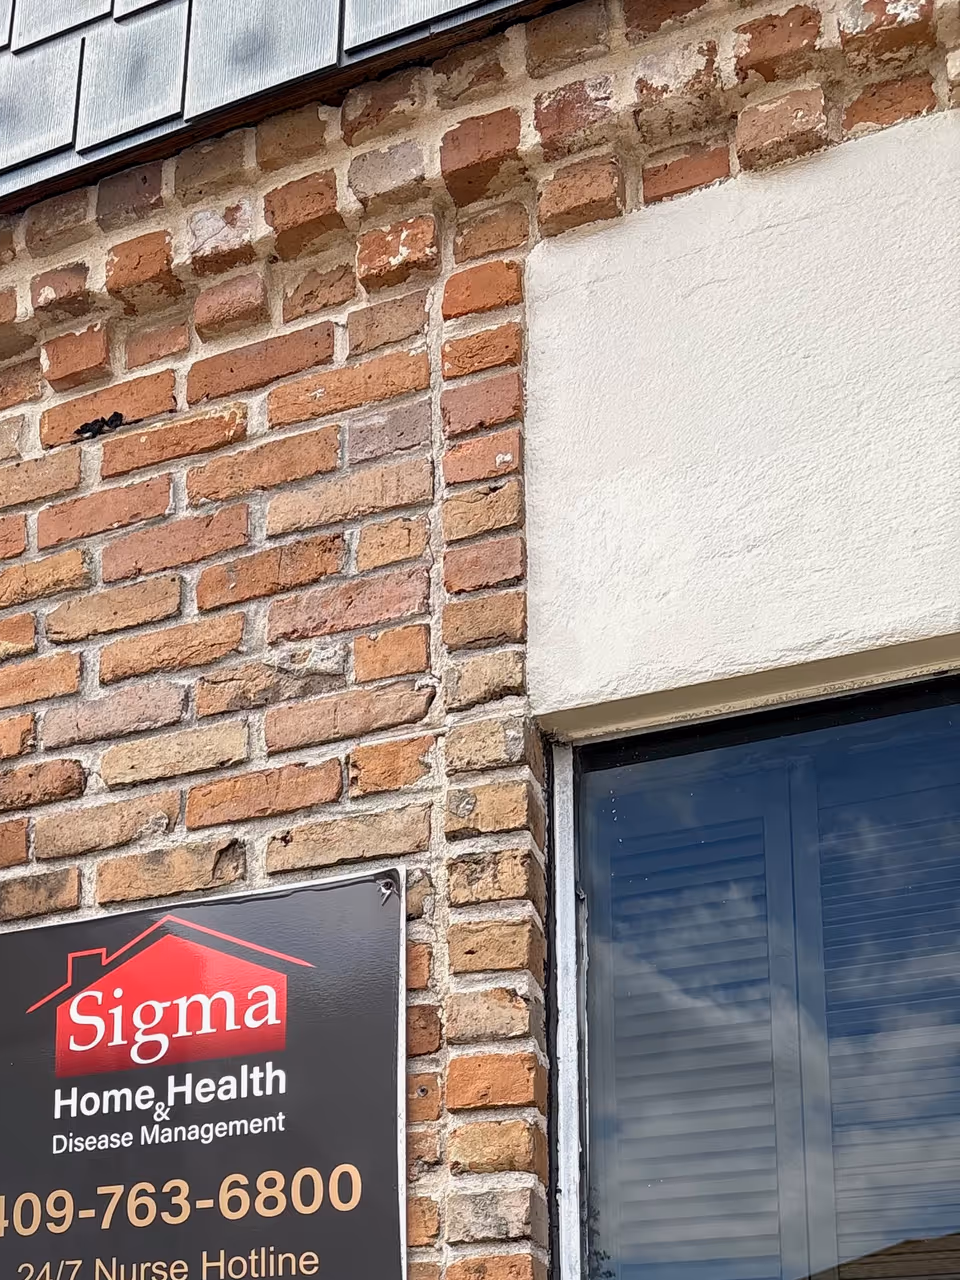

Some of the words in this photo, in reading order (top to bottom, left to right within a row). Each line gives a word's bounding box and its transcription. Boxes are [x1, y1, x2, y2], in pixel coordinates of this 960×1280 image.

[68, 984, 281, 1064] Sigma
[54, 1083, 155, 1120] Home
[167, 1061, 287, 1107] Health
[152, 1102, 171, 1122] &
[52, 1130, 134, 1155] Disease
[140, 1112, 286, 1146] Management
